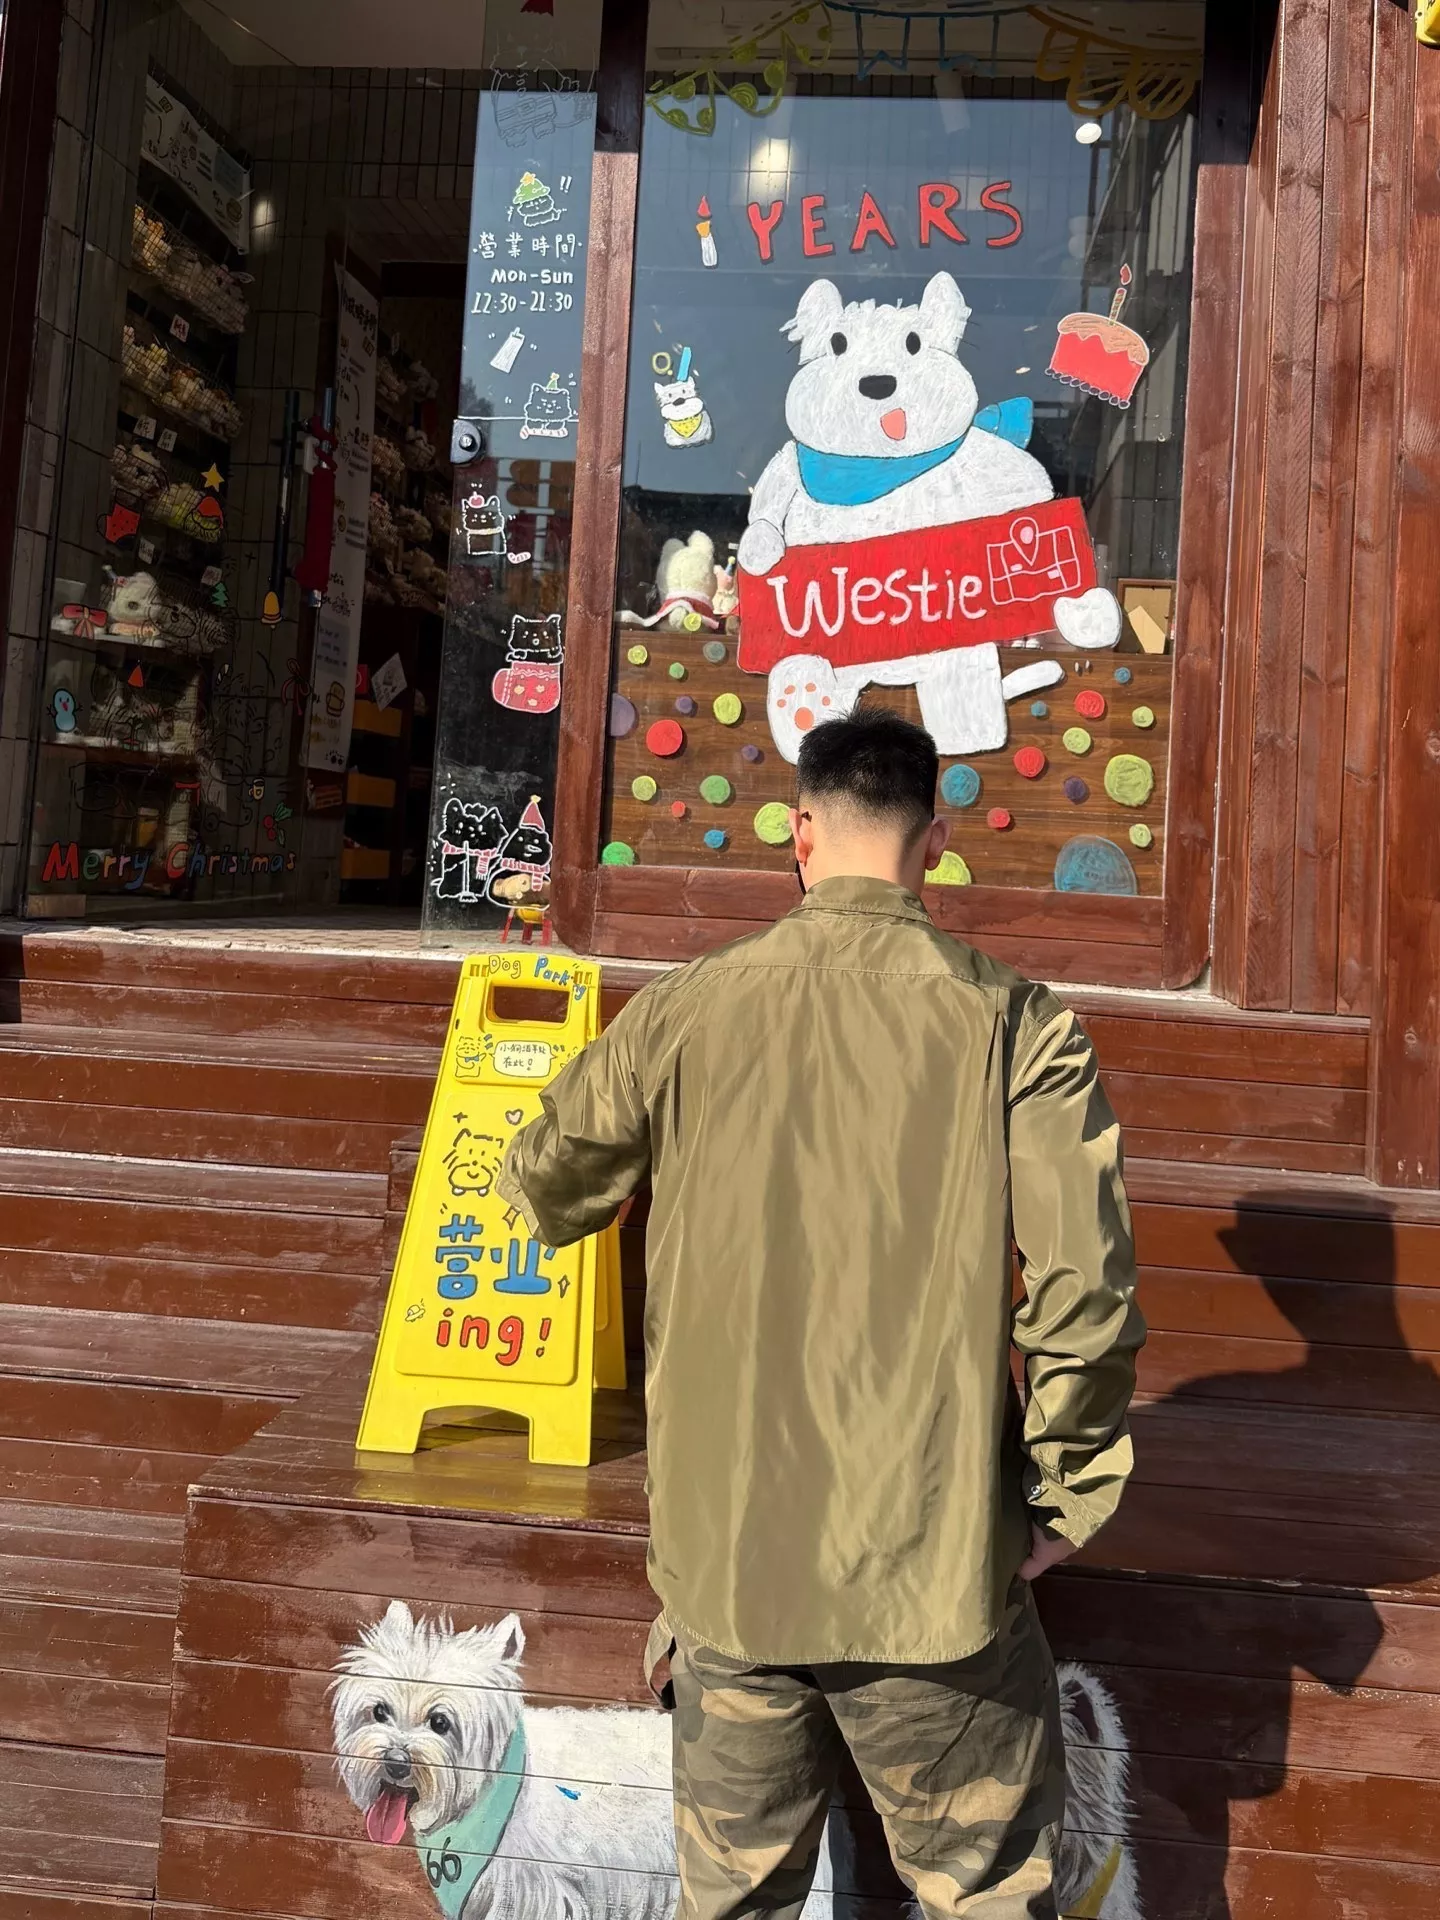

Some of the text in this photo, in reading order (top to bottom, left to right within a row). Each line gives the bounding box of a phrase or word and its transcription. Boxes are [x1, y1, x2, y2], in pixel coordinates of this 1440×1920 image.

[478, 231, 577, 259] 營業時間
[746, 180, 1024, 264] YEARS
[767, 566, 988, 637] Westie
[41, 838, 297, 892] Merry Christmas
[488, 954, 522, 979] Dog
[435, 1213, 557, 1300] 营业
[436, 1307, 552, 1366] ing!
